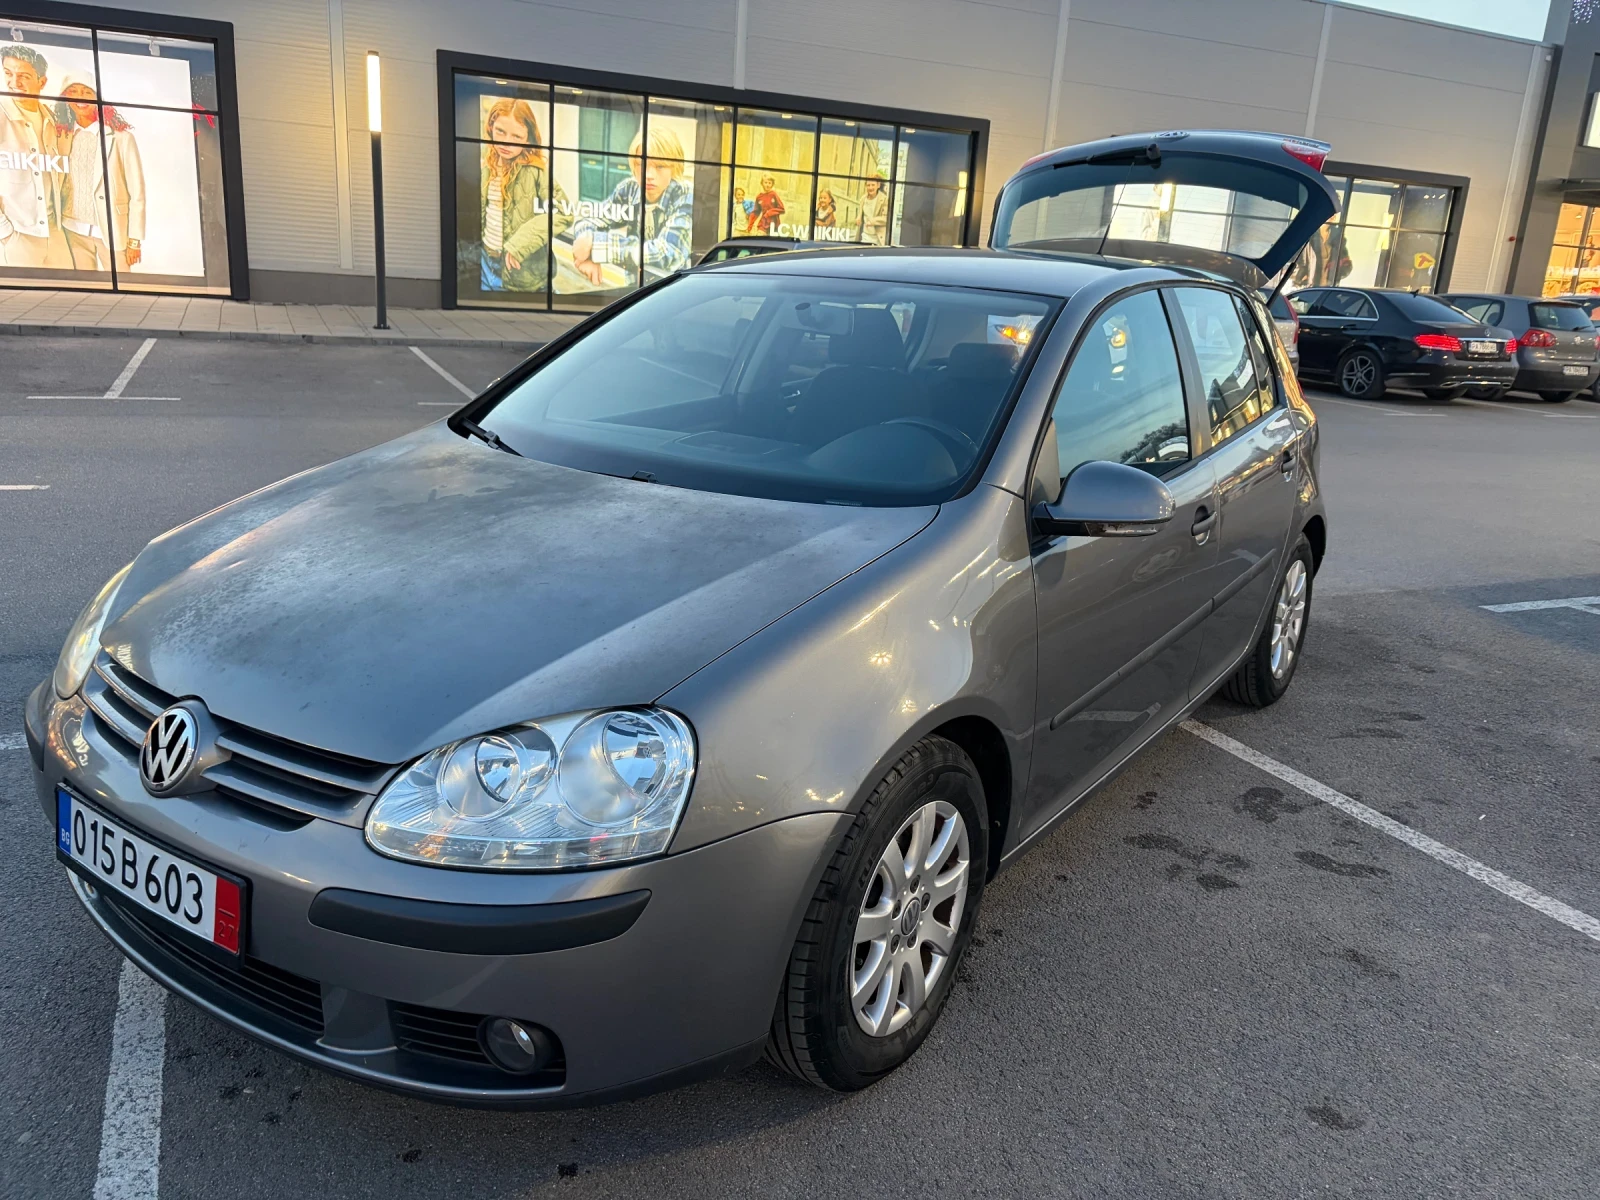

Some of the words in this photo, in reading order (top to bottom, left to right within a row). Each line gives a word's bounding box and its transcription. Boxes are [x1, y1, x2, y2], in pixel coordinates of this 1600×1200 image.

[769, 221, 791, 238] LC
[61, 827, 71, 847] BG
[218, 920, 235, 941] 27
